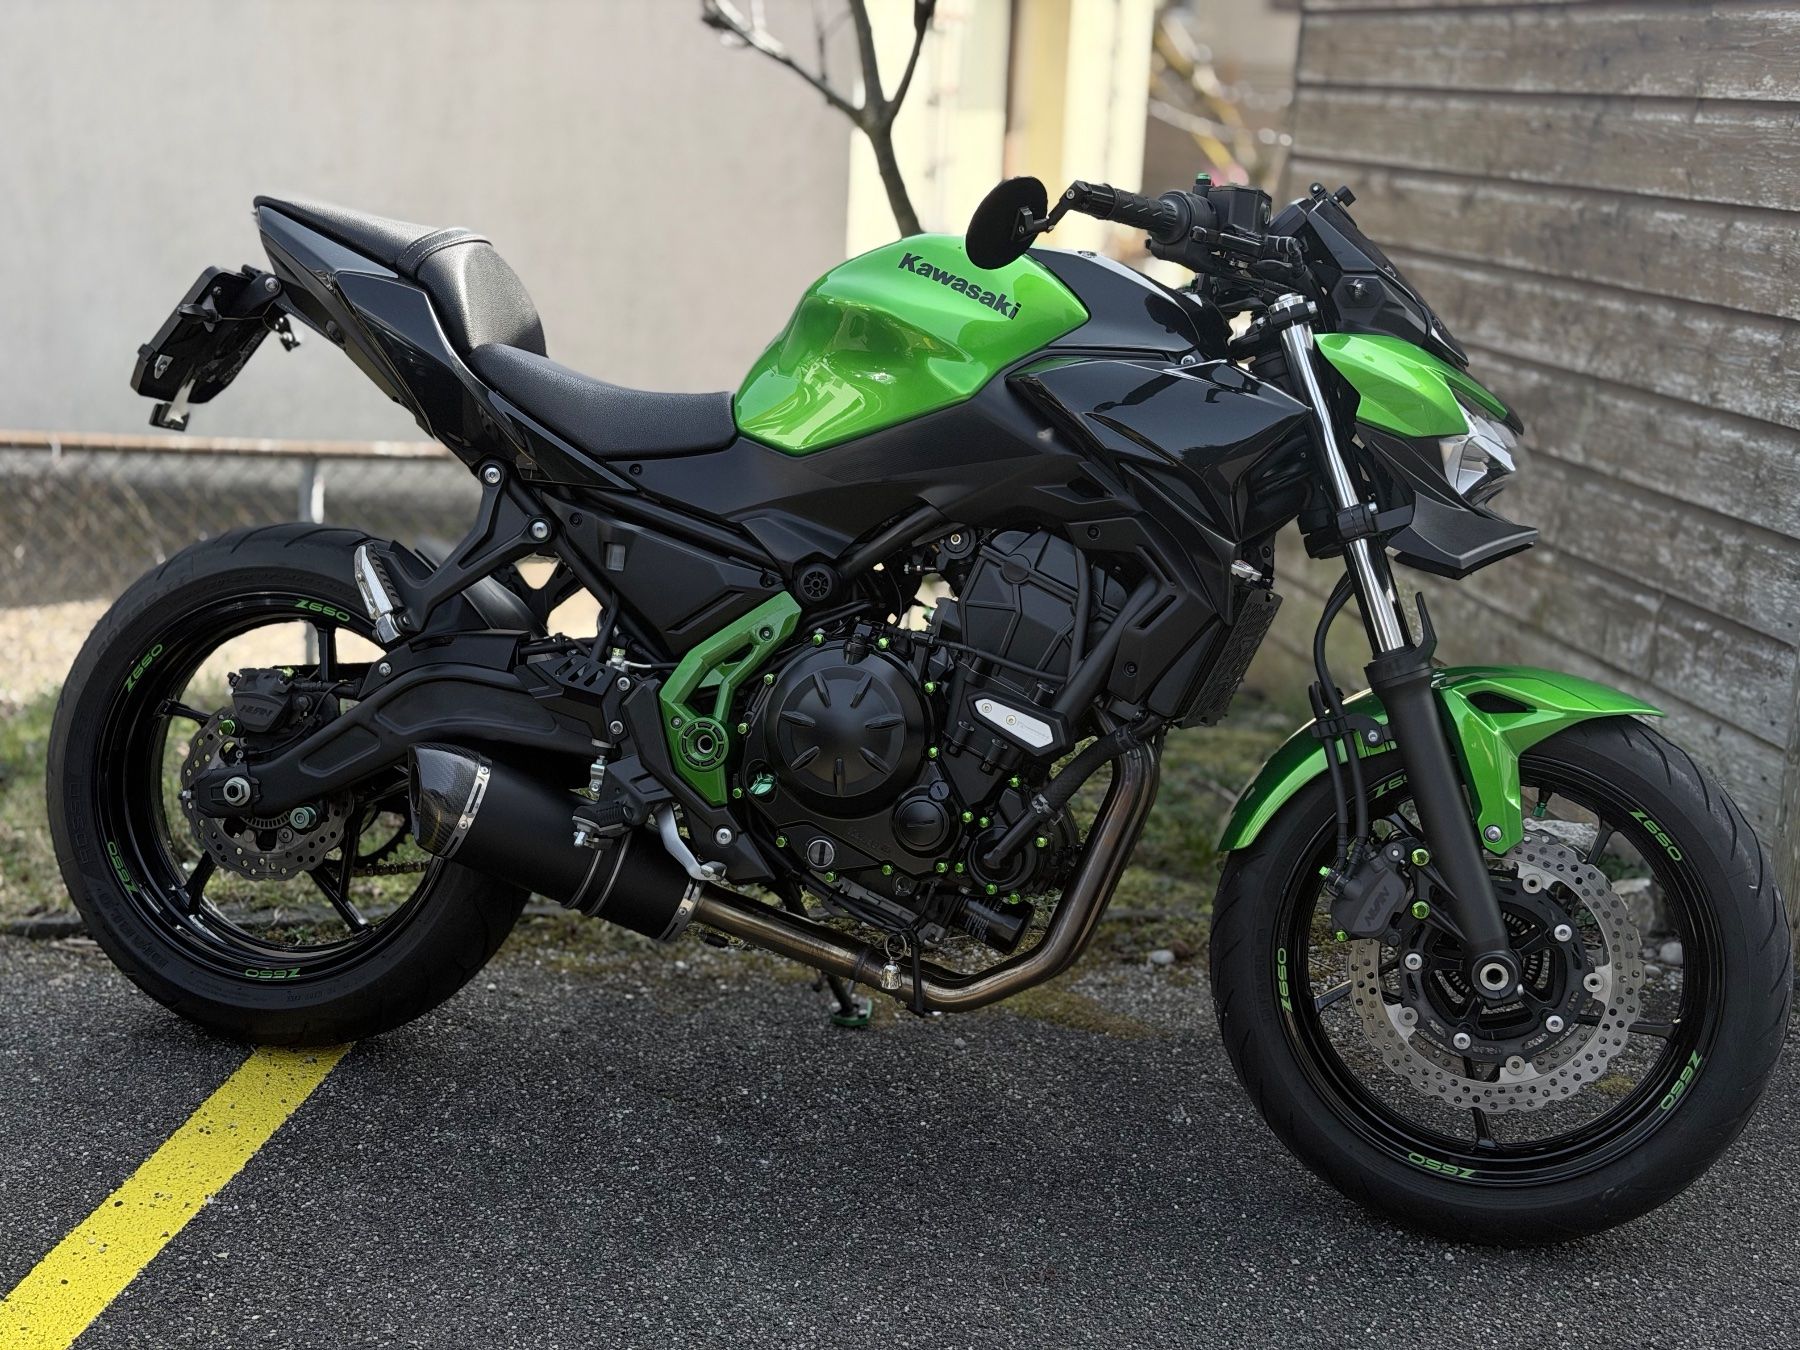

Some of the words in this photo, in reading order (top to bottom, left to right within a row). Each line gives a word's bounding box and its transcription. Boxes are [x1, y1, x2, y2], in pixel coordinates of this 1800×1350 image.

[898, 253, 1022, 320] Kawasaki
[294, 599, 351, 622] Z650
[124, 643, 164, 692] Z650
[1372, 774, 1408, 799] Z6
[1629, 809, 1682, 862] Z650
[106, 841, 139, 893] Z650
[245, 966, 302, 981] Z650
[1276, 946, 1294, 1014] Z650
[1661, 1049, 1702, 1111] Z650
[1408, 1151, 1476, 1179] Z650
